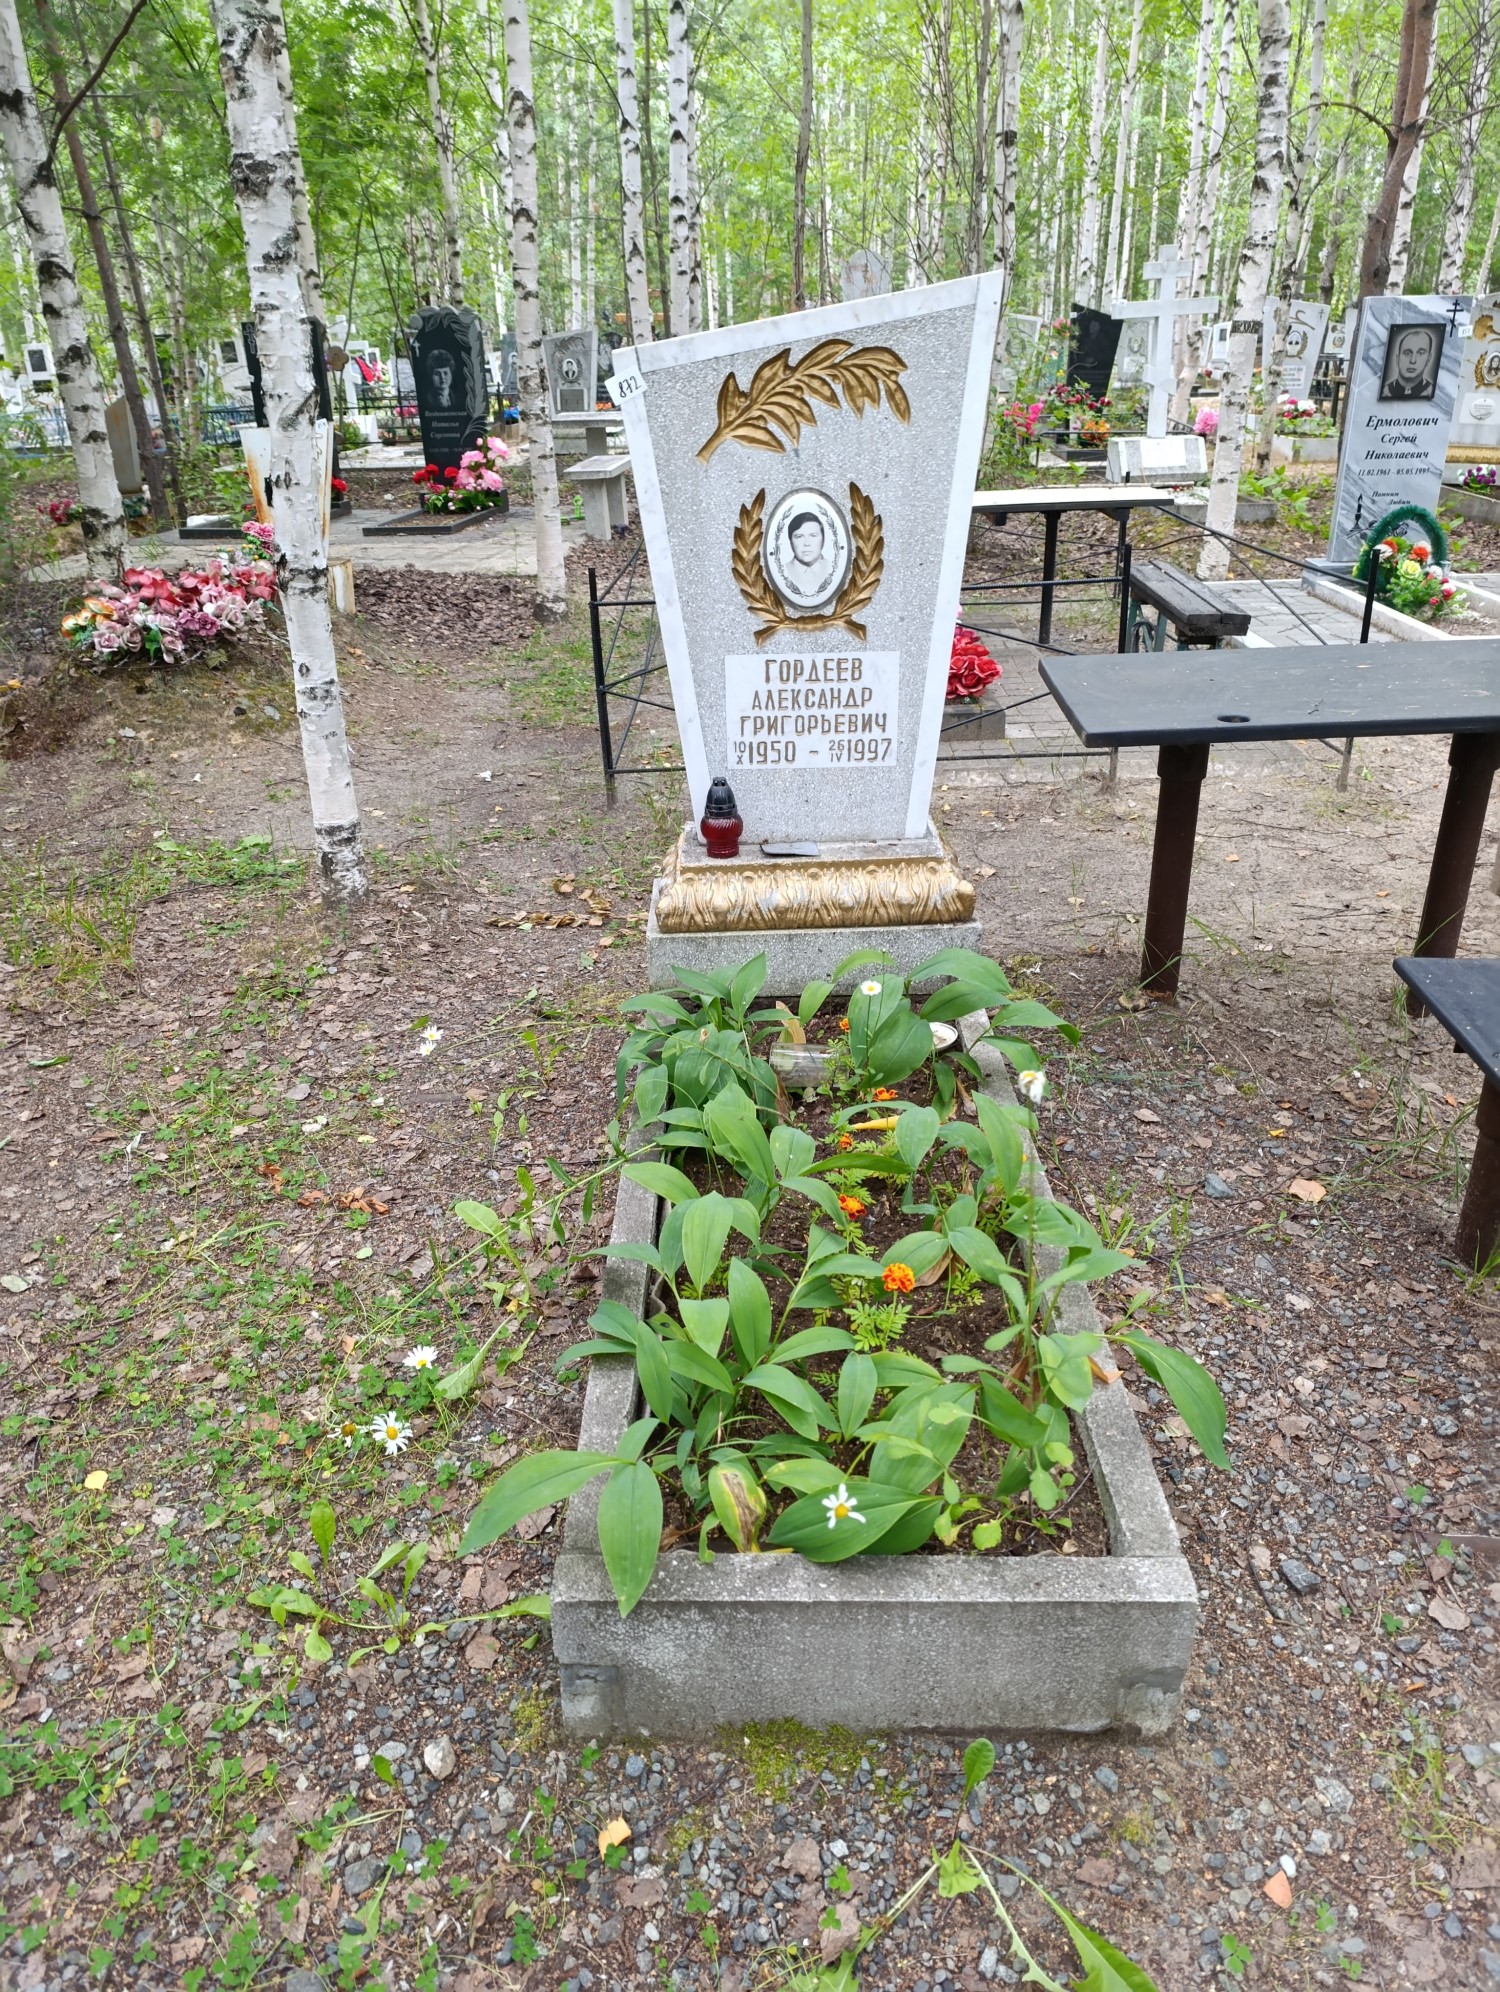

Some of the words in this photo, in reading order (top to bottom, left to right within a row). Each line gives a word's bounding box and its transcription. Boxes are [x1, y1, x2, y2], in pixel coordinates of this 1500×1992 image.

[618, 375, 642, 398] 872
[1365, 415, 1439, 431] Ермолович
[1381, 433, 1418, 446] Сергей
[1364, 450, 1429, 460] Николаевич
[764, 657, 863, 684] ГОРДЕЕВ
[751, 687, 873, 711] АЛЕКСАНДР
[740, 713, 888, 737] ГРИГОРЬЕВИЧ
[749, 741, 796, 765] 1950
[847, 738, 892, 762] 1997
